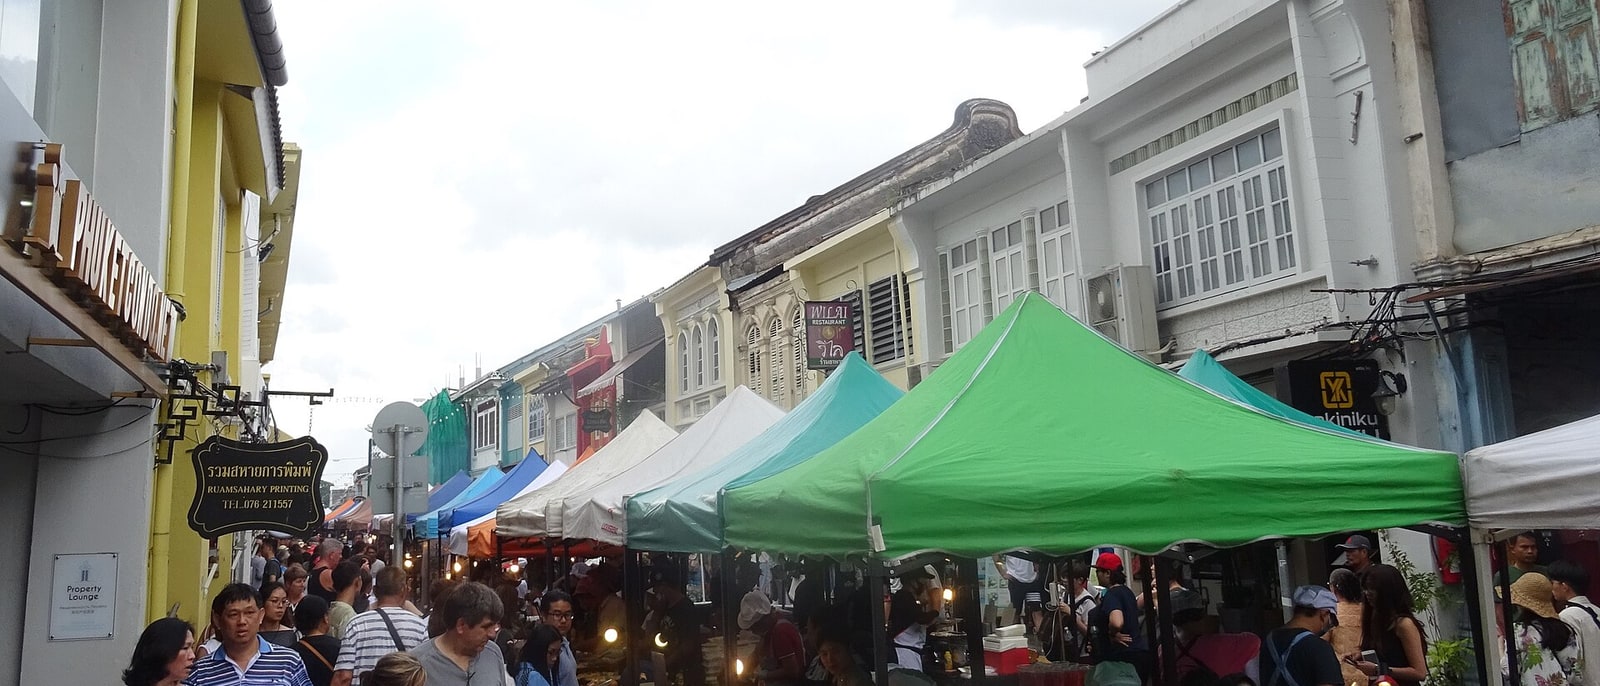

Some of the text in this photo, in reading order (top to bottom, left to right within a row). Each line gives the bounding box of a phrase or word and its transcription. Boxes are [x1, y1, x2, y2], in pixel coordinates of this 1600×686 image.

[811, 304, 848, 319] WILAI
[1314, 411, 1378, 426] kiniku
[207, 460, 313, 478] รวมสหายการพิมพ์
[207, 485, 310, 494] RUAMSAHARY PRINTING
[262, 499, 294, 509] 211557
[66, 585, 102, 593] Property
[68, 593, 99, 601] Lounge
